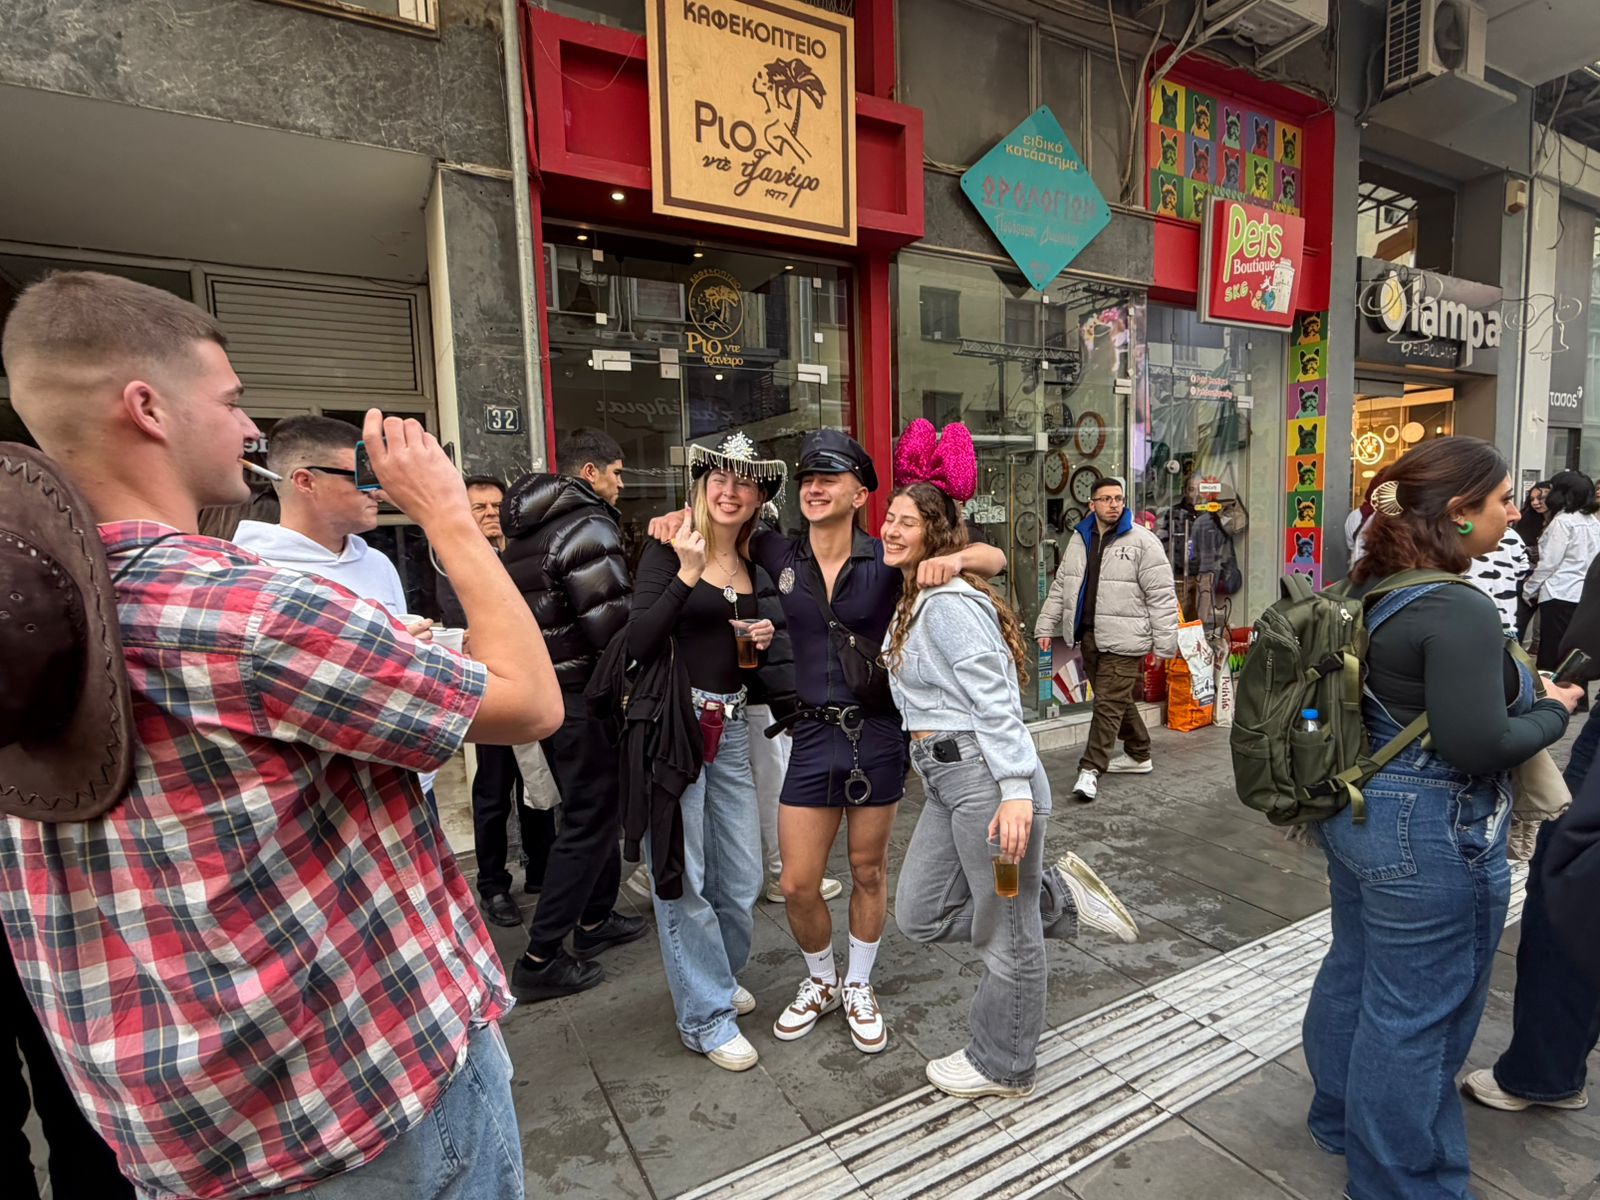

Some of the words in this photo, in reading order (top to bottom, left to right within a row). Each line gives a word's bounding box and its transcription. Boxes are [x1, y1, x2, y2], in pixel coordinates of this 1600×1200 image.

[684, 0, 827, 59] ΚΑΦΕΚΟΠΤΕΙΟ
[1005, 143, 1078, 172] κατάστημα
[764, 188, 788, 201] 1977
[1223, 203, 1283, 283] Pets
[1233, 258, 1275, 276] Boutique
[1224, 281, 1249, 302] SKG
[492, 409, 515, 429] 32
